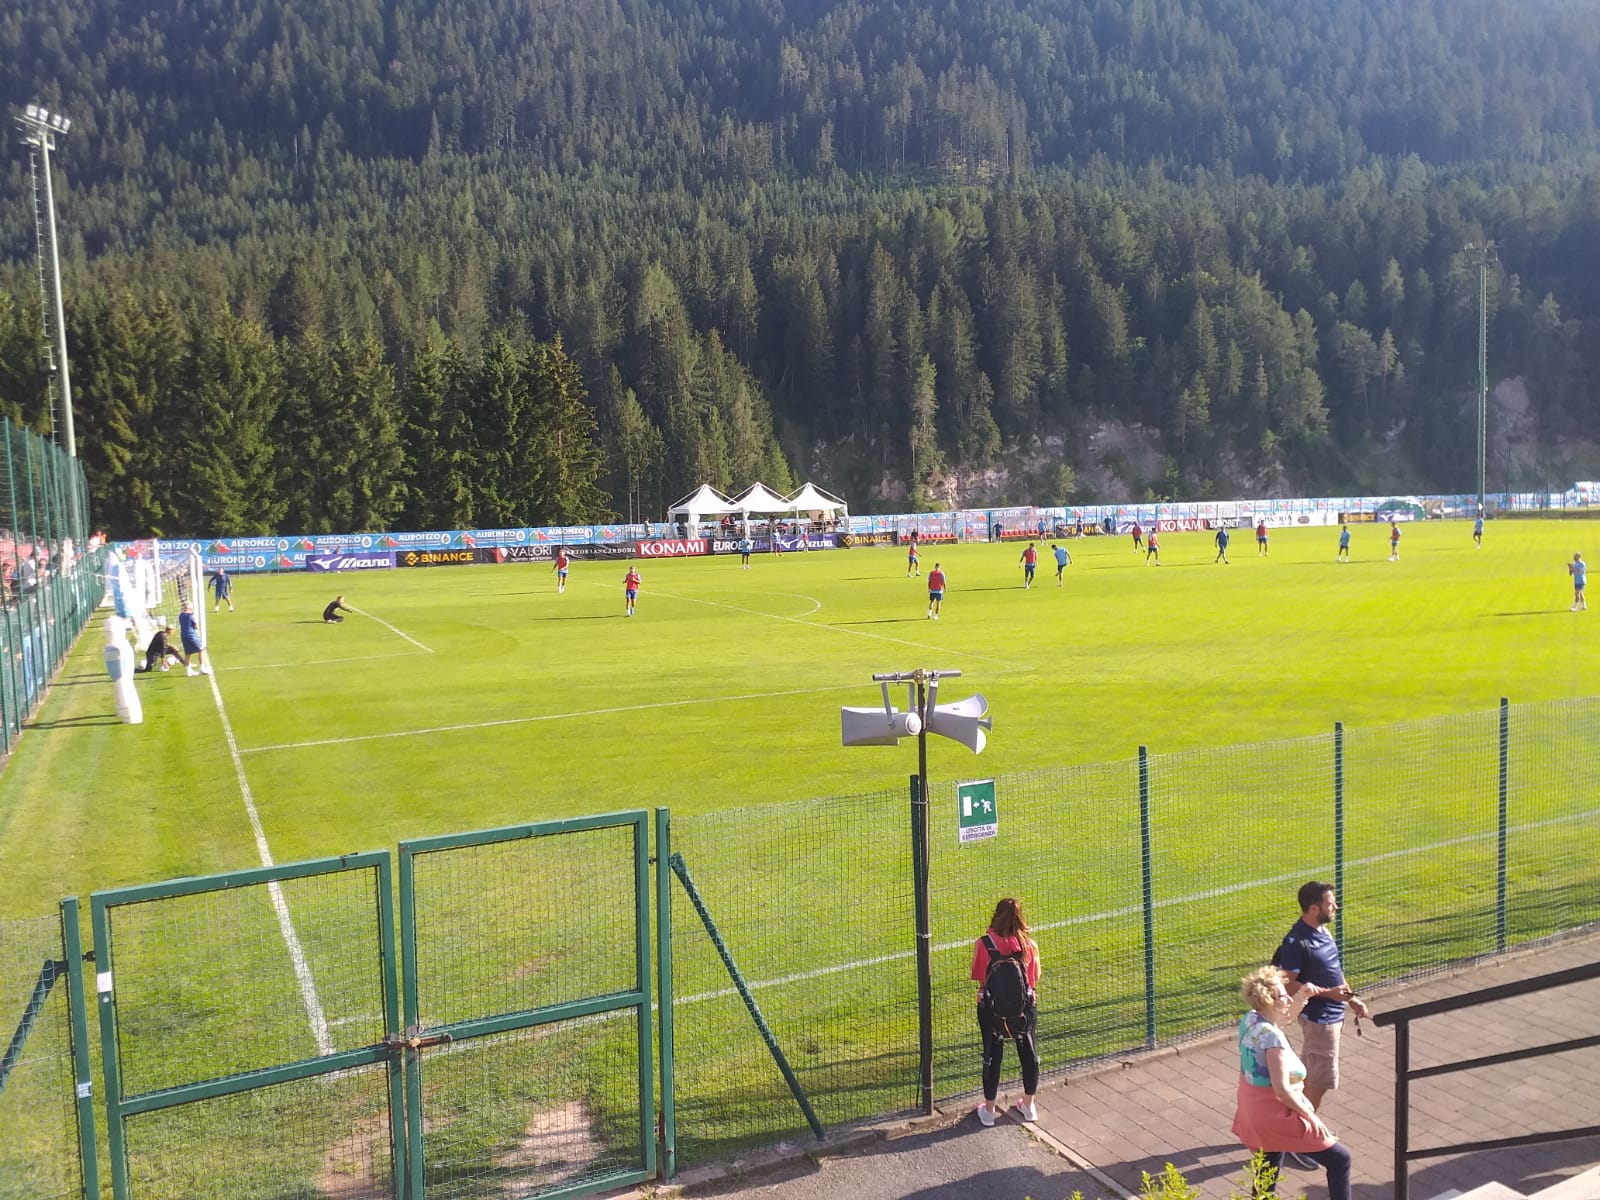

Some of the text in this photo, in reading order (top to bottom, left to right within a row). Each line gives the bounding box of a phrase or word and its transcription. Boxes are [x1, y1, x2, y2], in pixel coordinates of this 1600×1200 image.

[1160, 519, 1204, 531] KONAMI
[854, 535, 892, 544] BINANCE
[510, 545, 552, 557] VALORI
[641, 541, 704, 555] KONAMI
[421, 552, 474, 563] BINANCE
